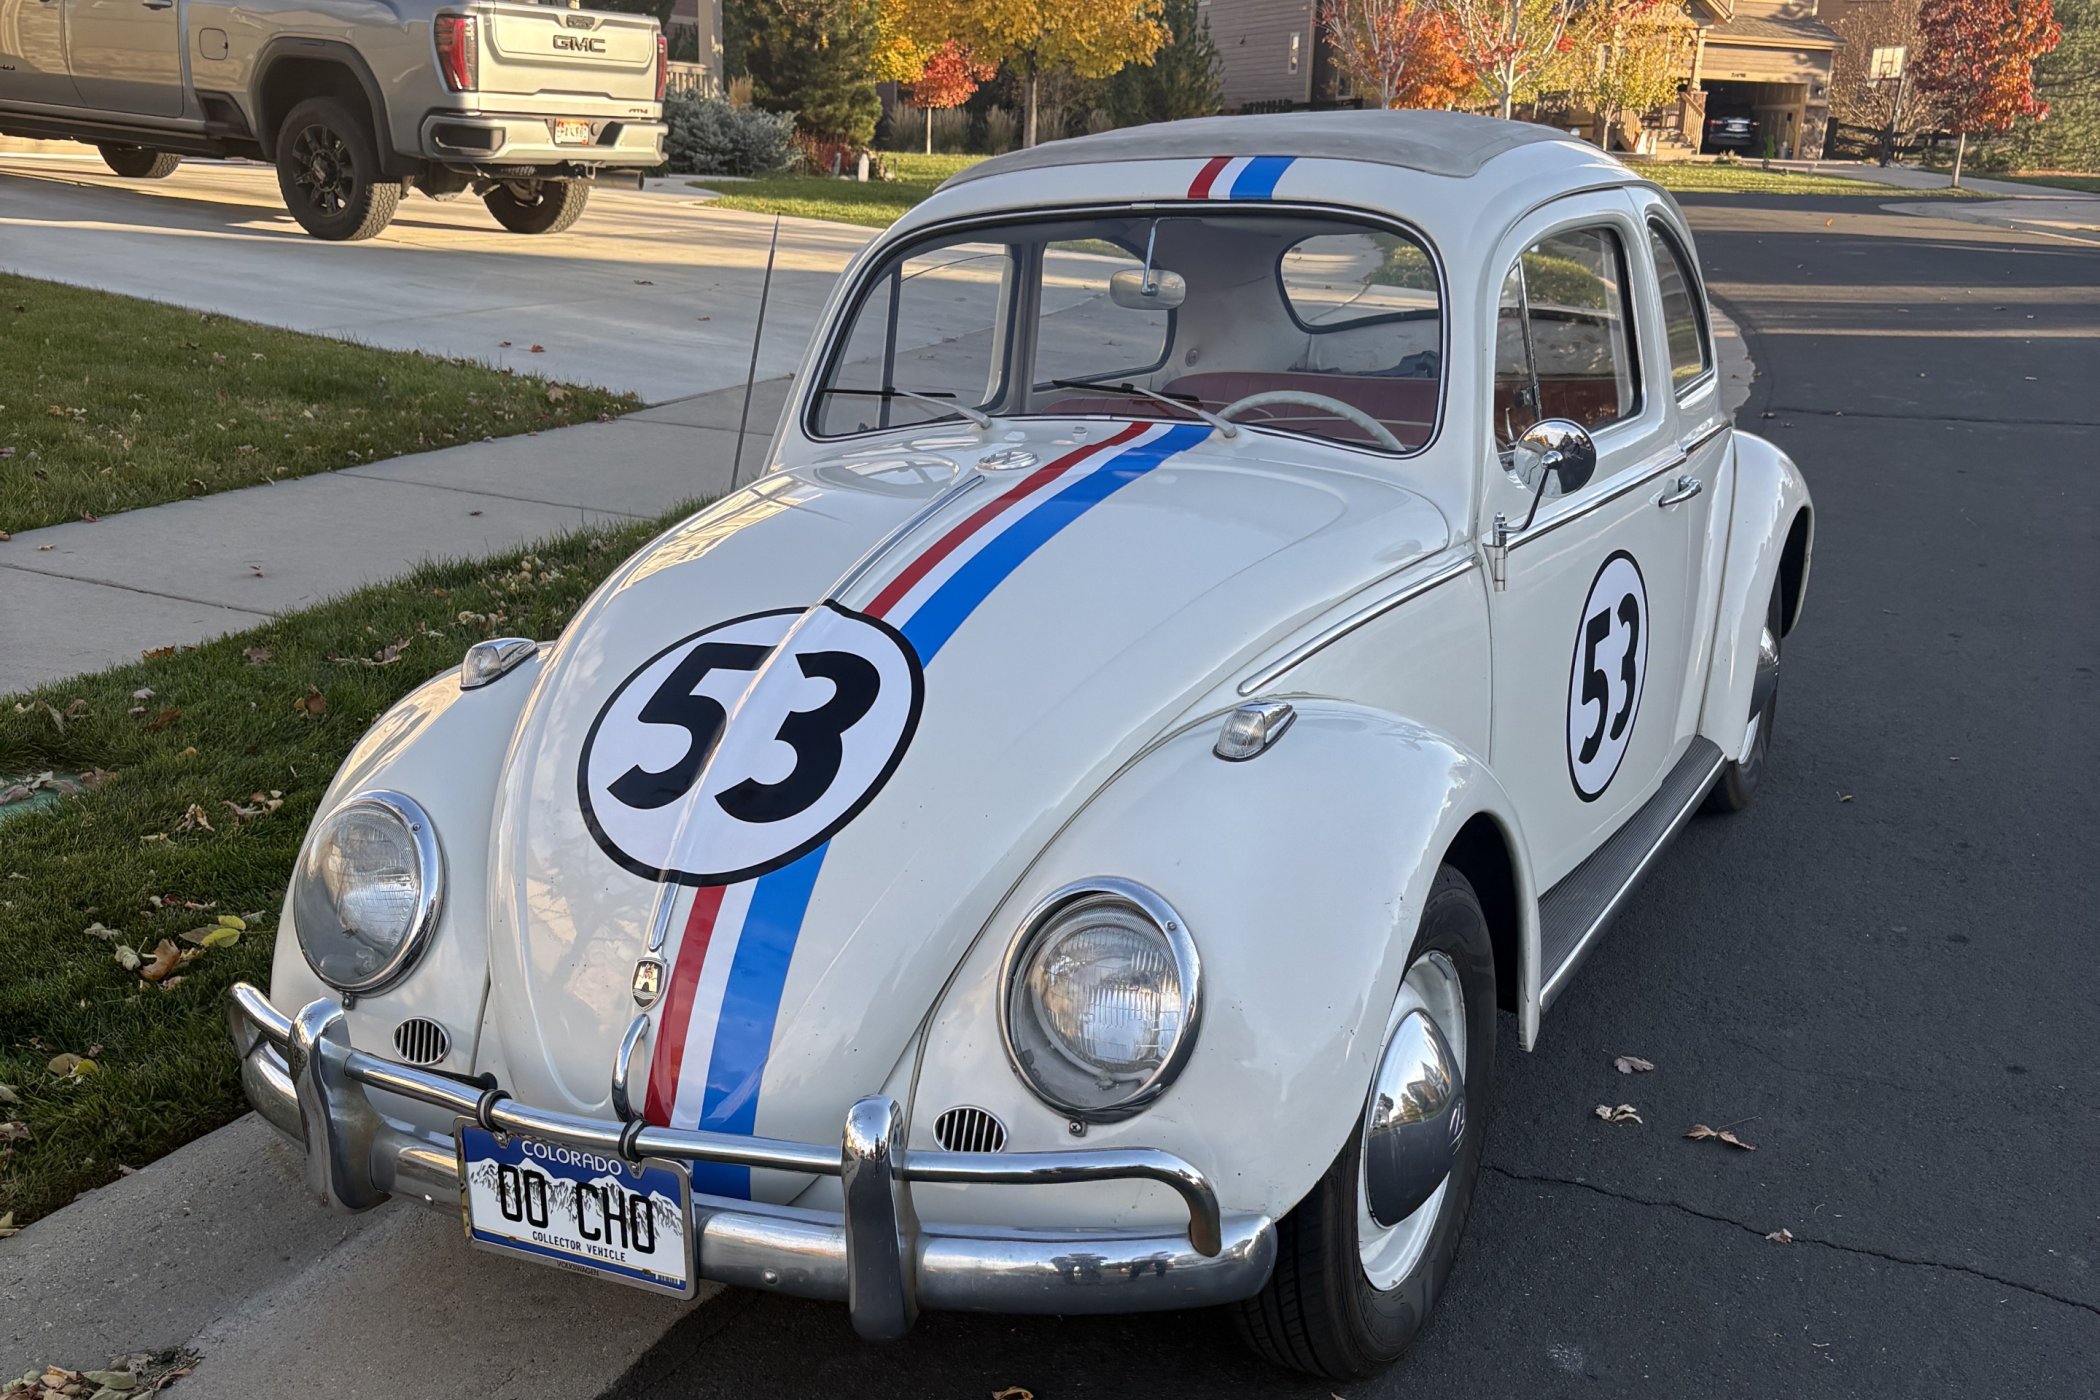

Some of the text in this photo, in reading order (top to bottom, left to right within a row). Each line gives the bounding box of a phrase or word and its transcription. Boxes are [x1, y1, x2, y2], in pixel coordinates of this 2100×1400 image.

[553, 34, 606, 53] GMC
[1578, 592, 1640, 765] 53
[606, 642, 881, 824] 53
[521, 1140, 622, 1176] COLORADO
[532, 1230, 626, 1263] COLLECTOR VEHICLE
[556, 1261, 600, 1277] VOLKSWAGEN
